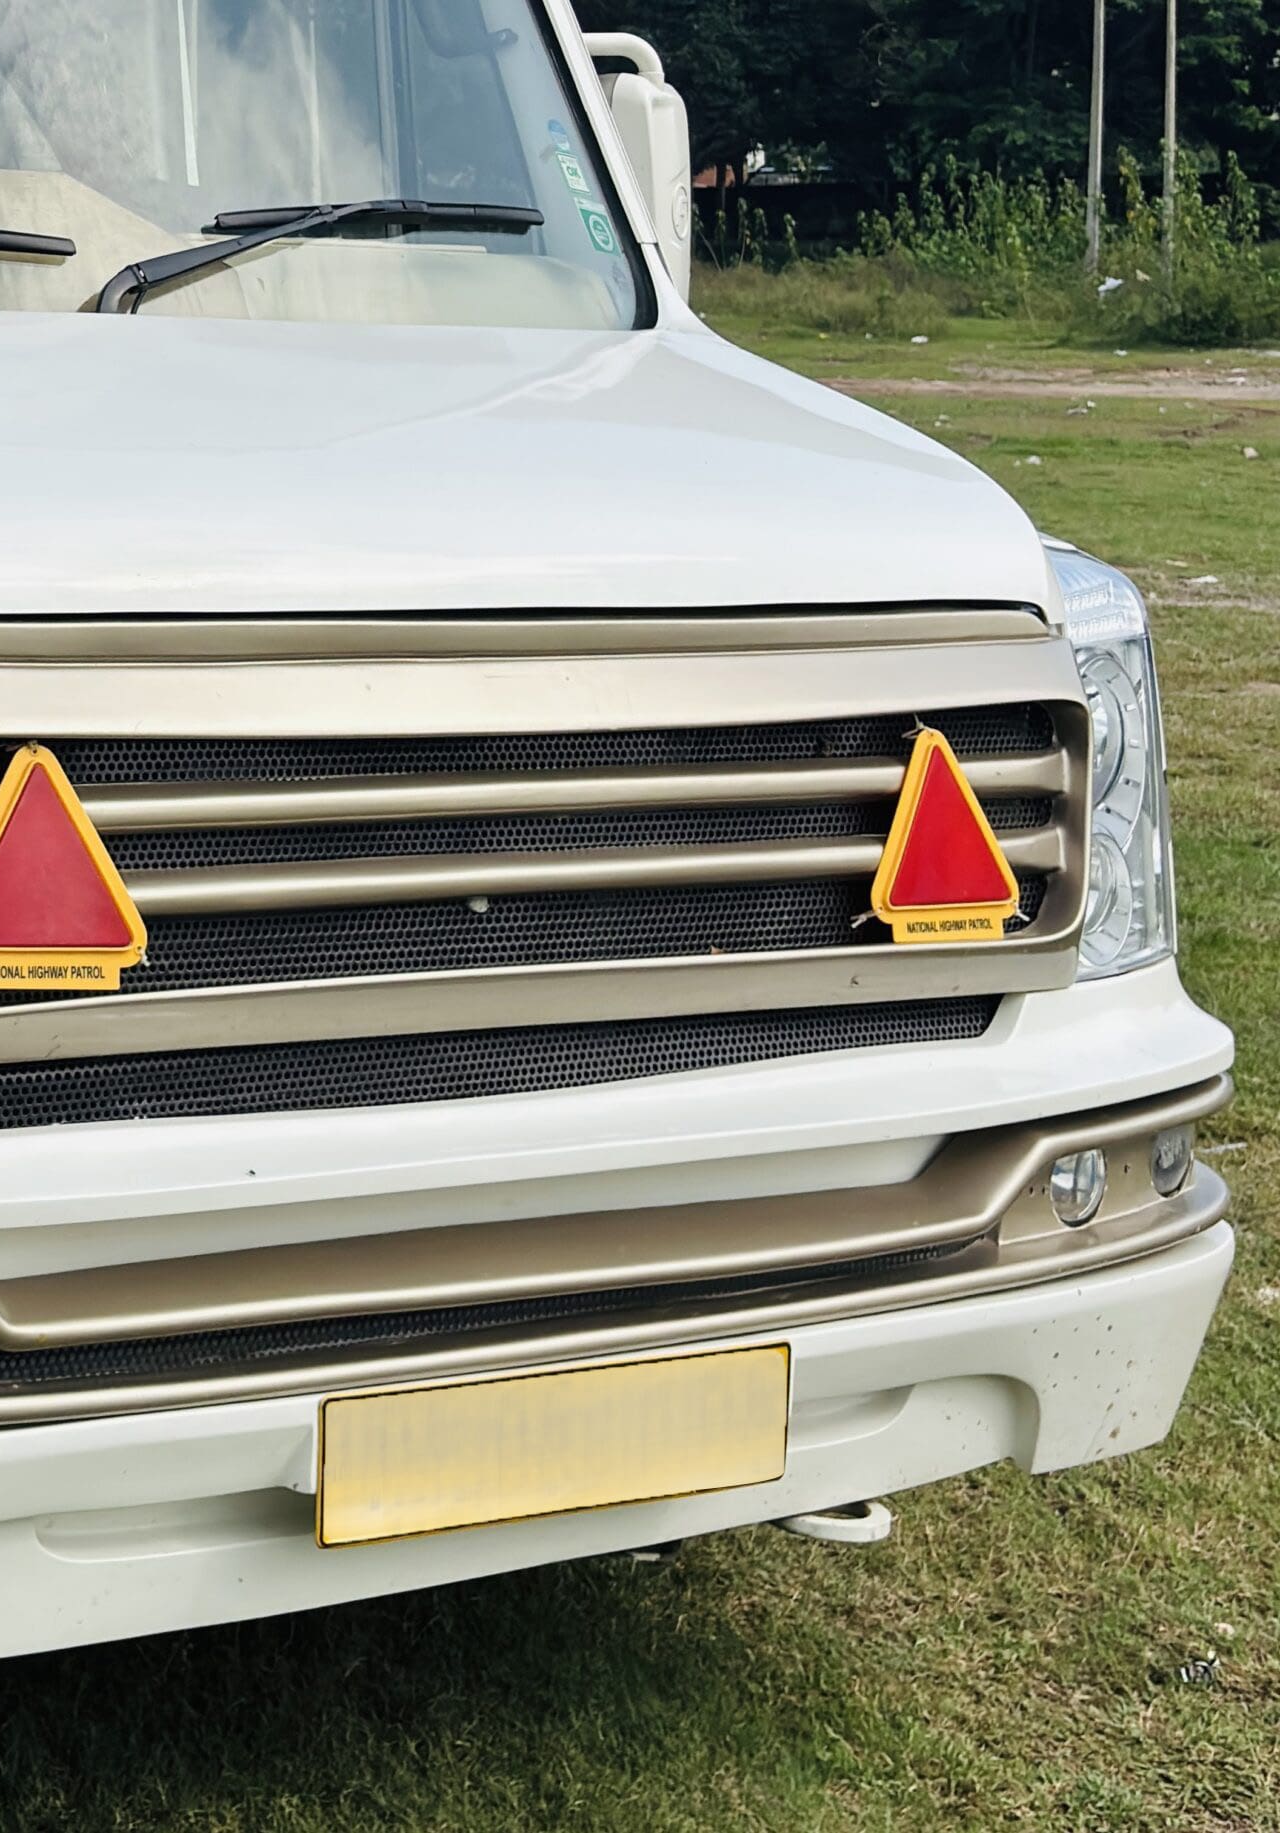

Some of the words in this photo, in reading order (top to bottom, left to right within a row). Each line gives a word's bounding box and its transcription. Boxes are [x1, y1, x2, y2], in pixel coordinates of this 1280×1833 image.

[906, 920, 938, 934] NATIONAL
[939, 919, 967, 932] HIGHWAY
[968, 918, 993, 930] PATROL
[28, 965, 69, 979] HIGHWAY
[70, 966, 106, 980] PATROL
